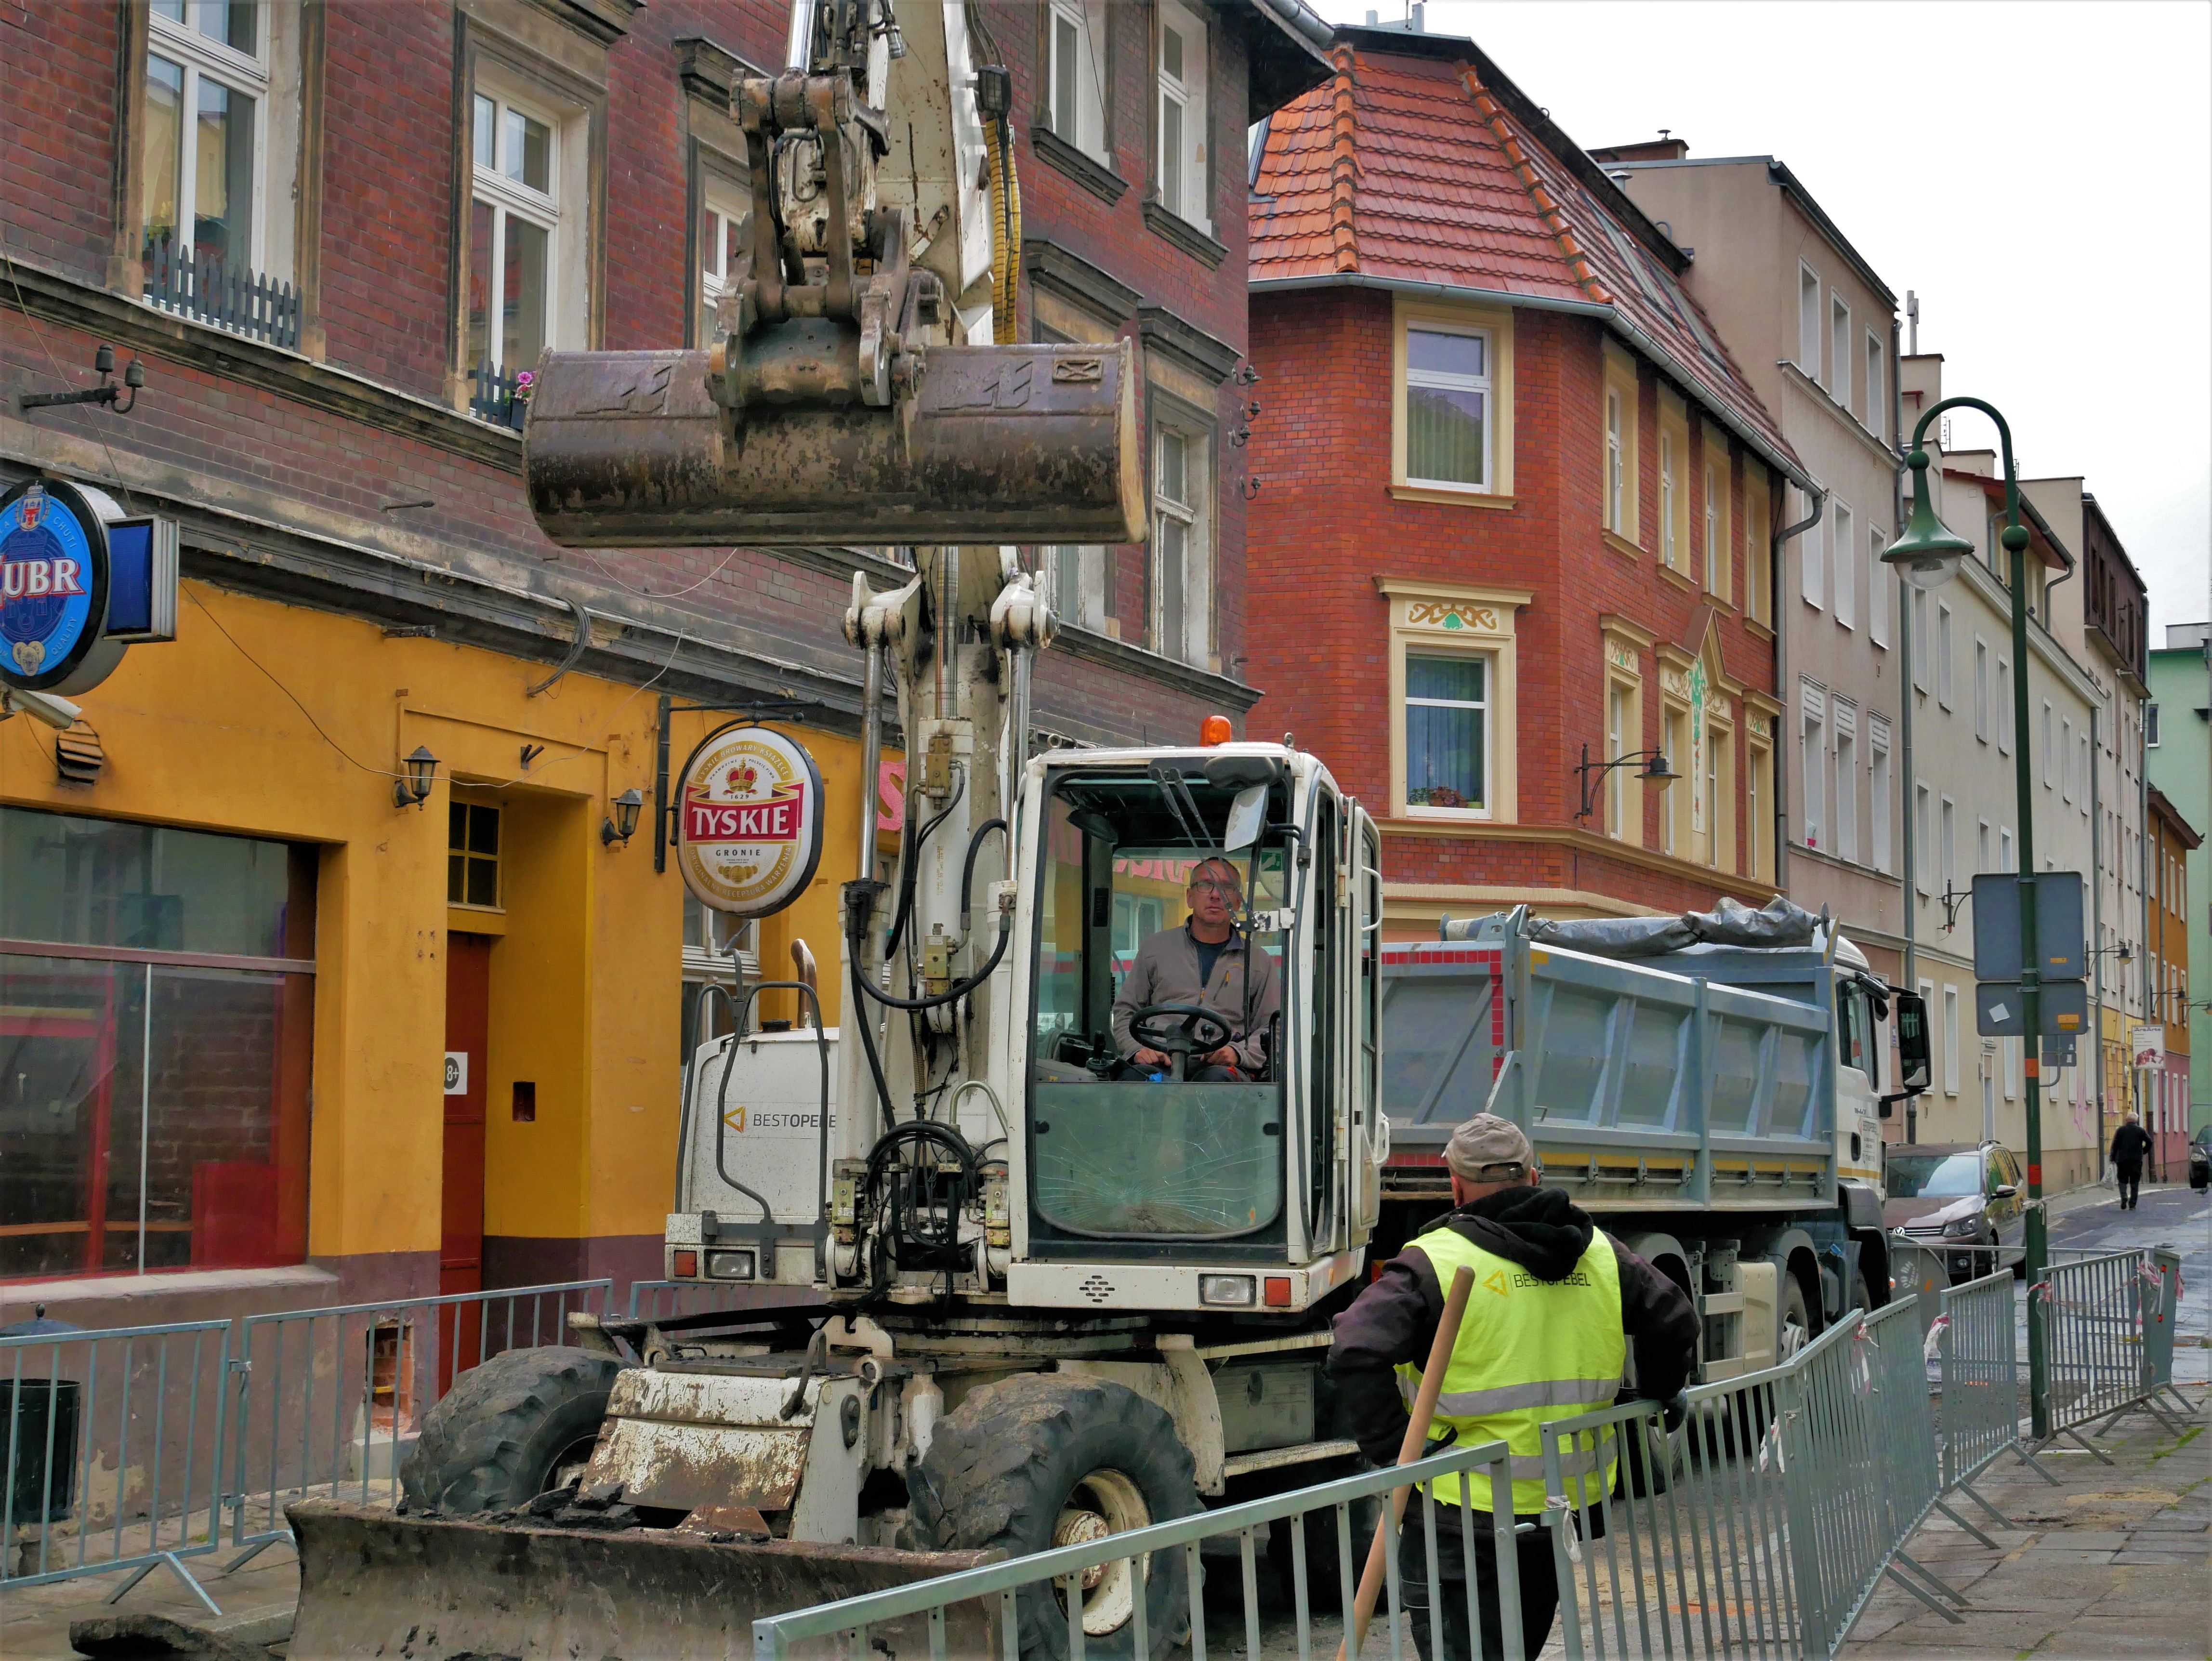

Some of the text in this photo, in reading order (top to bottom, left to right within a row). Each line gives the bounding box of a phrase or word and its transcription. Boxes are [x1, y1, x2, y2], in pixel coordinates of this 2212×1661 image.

[0, 556, 87, 600] UBR
[51, 617, 77, 656] QUALITY
[720, 744, 758, 759] BROWARY
[709, 758, 775, 780] PRAWDZIWE POLSKIE PIWO
[691, 805, 790, 836] TYSKIE
[689, 847, 792, 898] ORYGINALNA RECEPTURA WARZENIA
[444, 1064, 459, 1082] 8+
[753, 1114, 836, 1128] BESTOPEE
